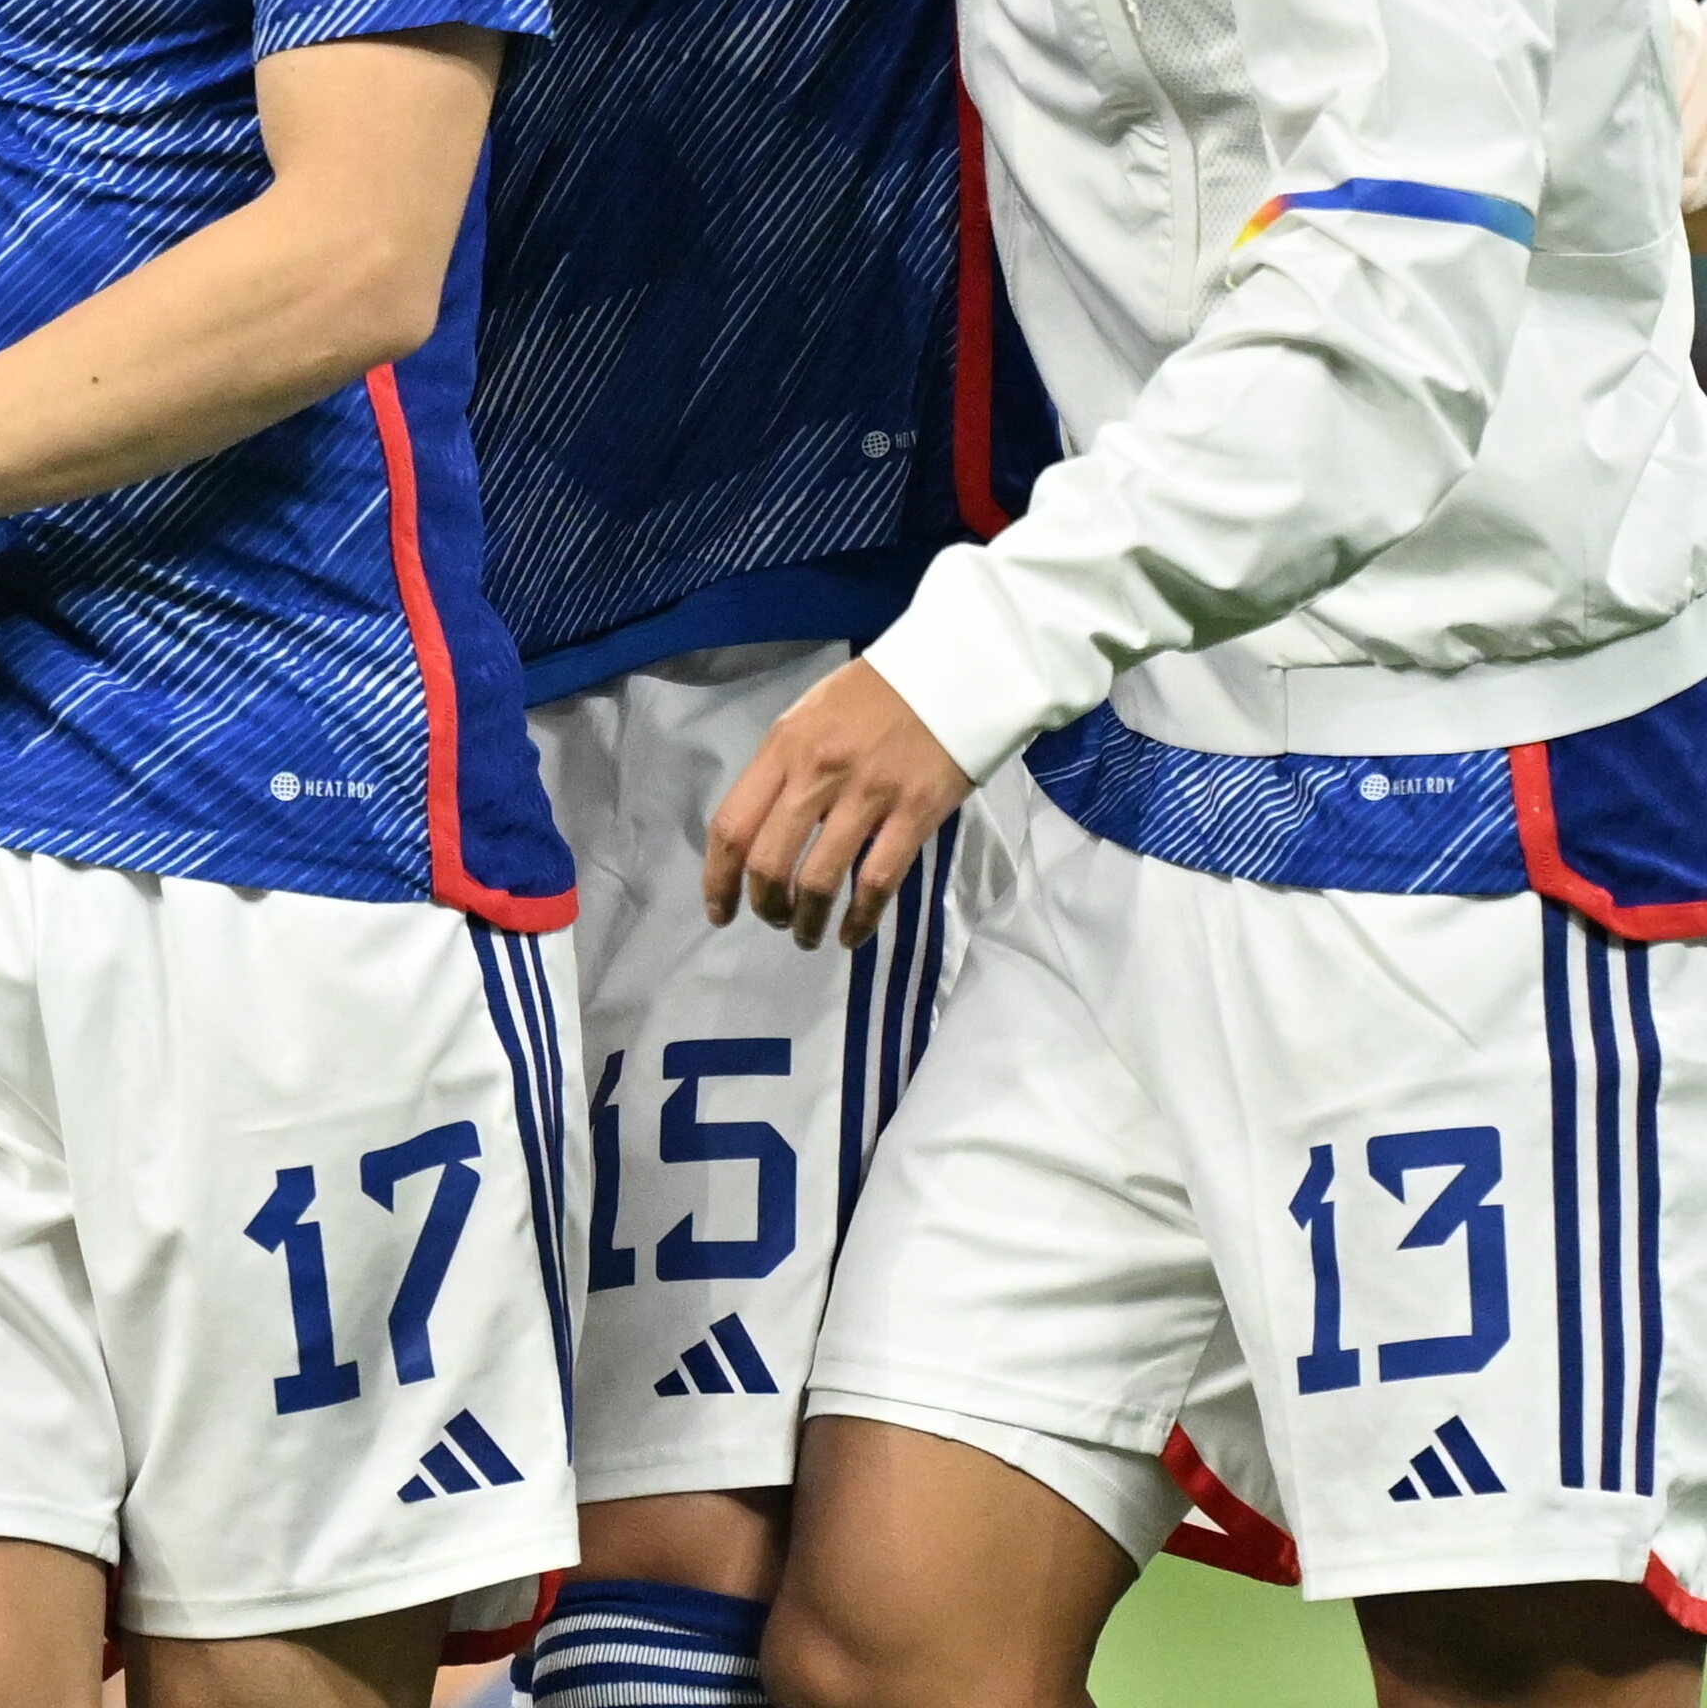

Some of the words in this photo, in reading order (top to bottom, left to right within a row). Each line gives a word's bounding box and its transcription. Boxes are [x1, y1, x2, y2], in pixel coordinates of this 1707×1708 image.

[242, 1120, 481, 1415] 17
[589, 1037, 797, 1293] 15
[1289, 1126, 1511, 1396] 13
